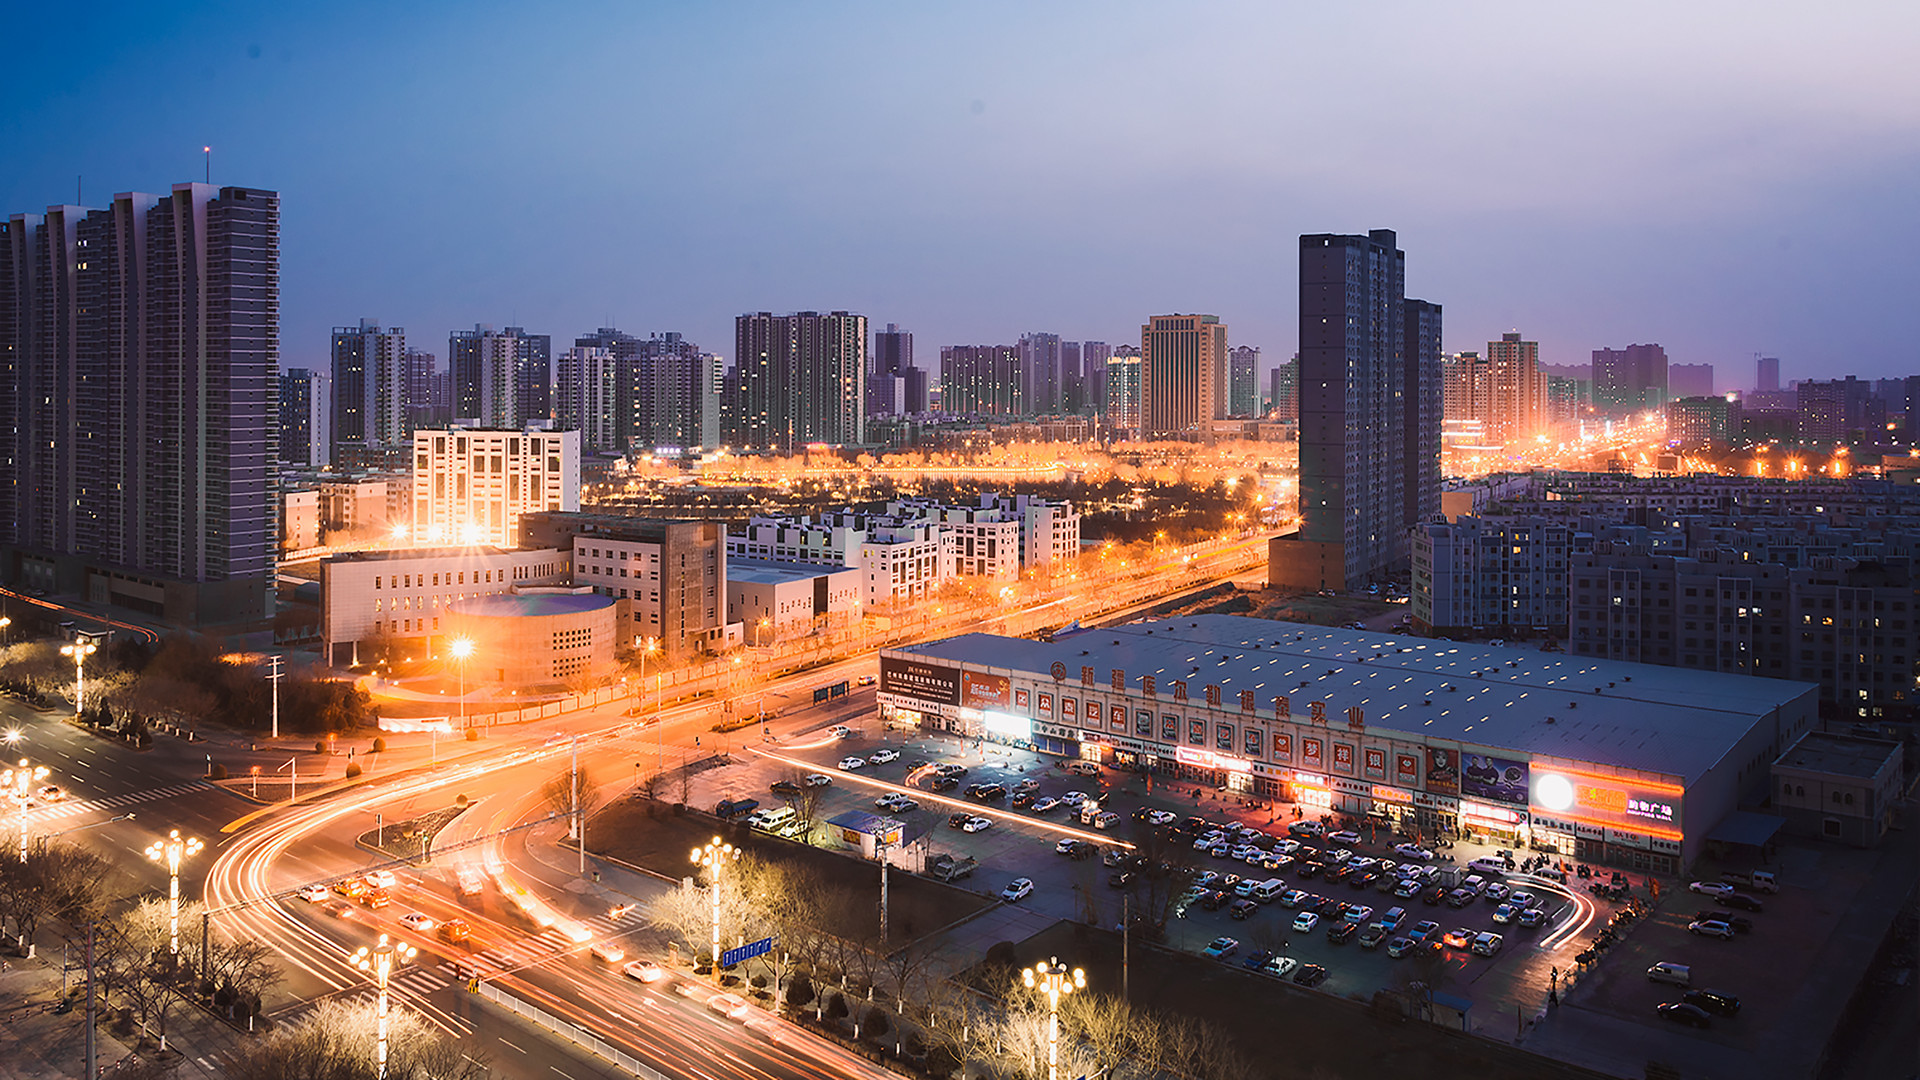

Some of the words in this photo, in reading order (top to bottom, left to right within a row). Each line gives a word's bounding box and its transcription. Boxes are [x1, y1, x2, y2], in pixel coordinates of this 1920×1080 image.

[1081, 665, 1364, 729] 新疆库尔勒银泰实业
[1627, 799, 1673, 816] 购物广场
